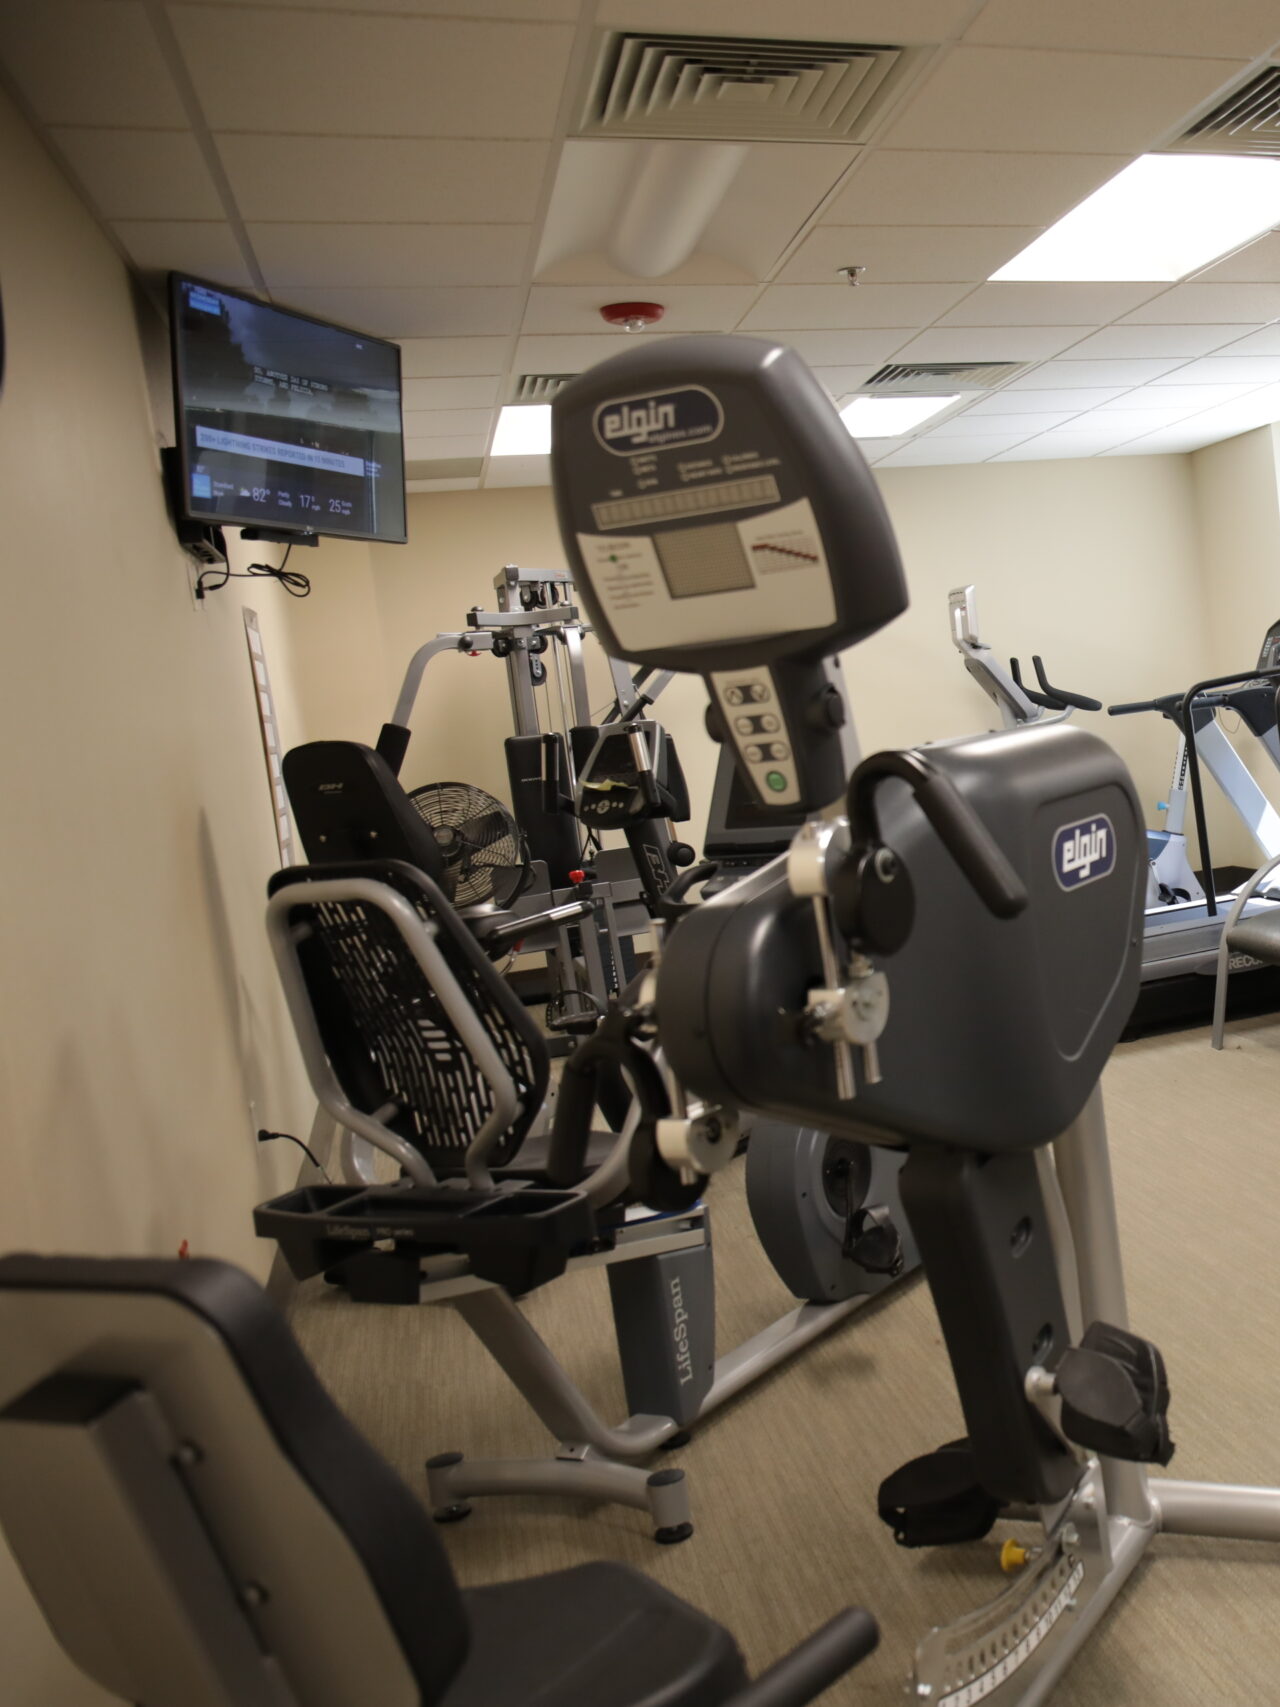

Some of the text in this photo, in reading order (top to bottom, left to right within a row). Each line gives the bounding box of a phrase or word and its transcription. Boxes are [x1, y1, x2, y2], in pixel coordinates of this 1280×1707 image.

[603, 399, 676, 444] elgin
[328, 499, 342, 513] 25
[1062, 823, 1108, 879] elgin
[670, 1276, 694, 1387] LifeSpan
